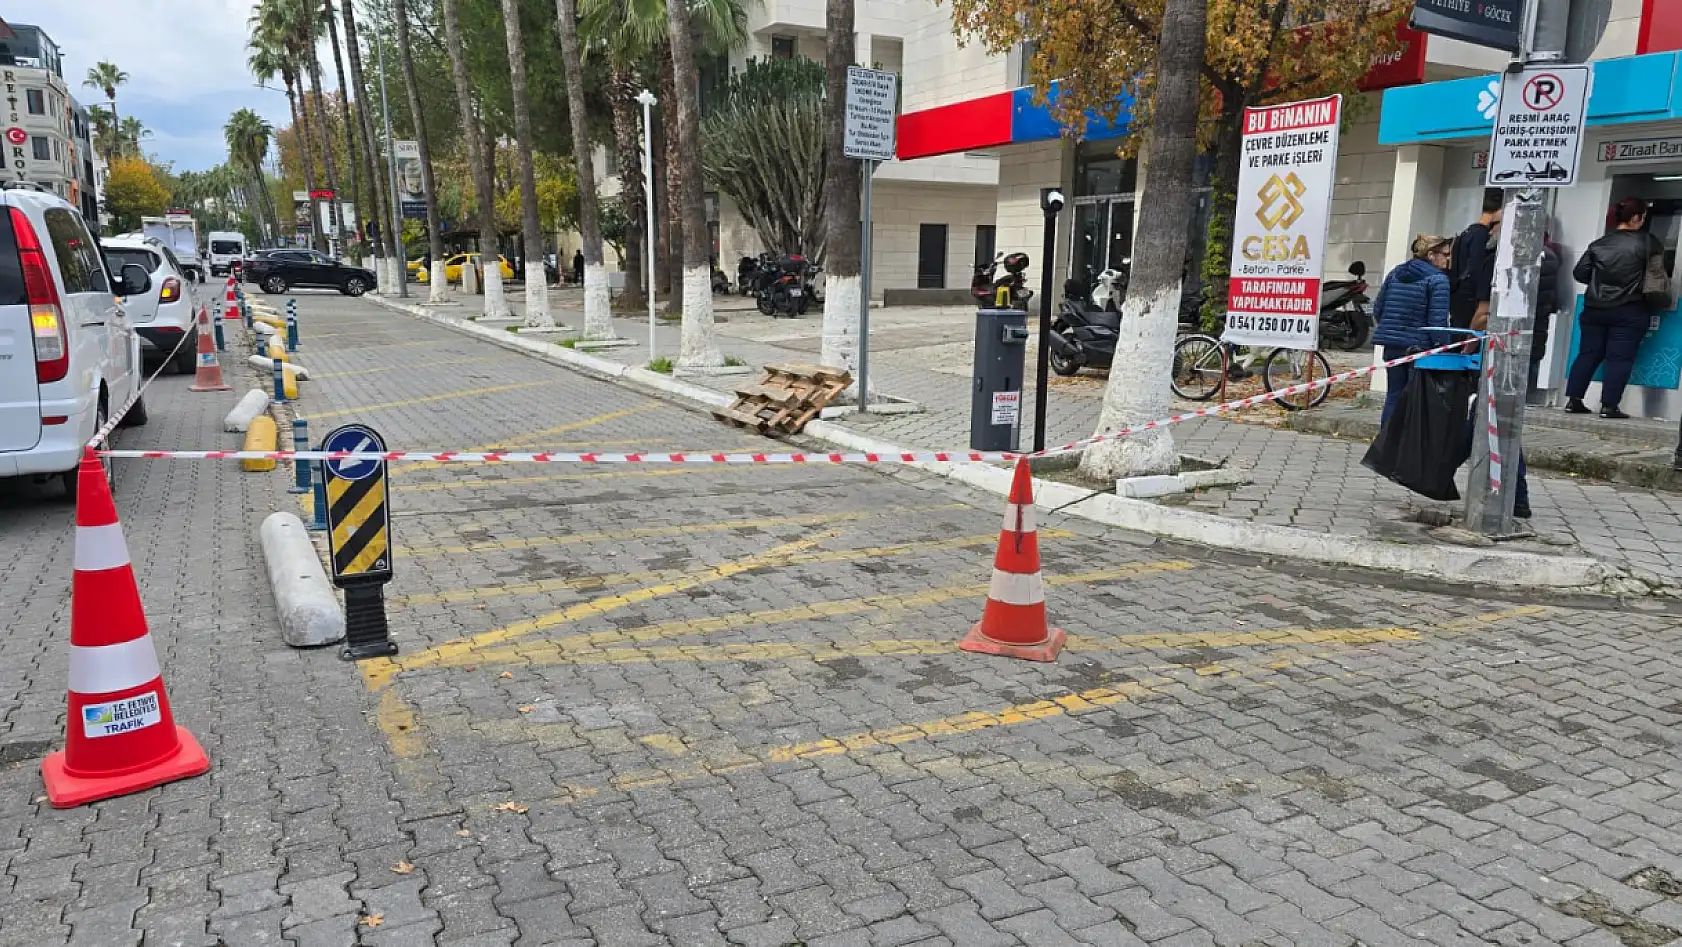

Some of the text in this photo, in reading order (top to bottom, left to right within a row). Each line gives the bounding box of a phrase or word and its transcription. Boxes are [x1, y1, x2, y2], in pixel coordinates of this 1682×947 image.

[1484, 4, 1512, 23] GÖCEK
[1248, 102, 1331, 132] BU BİNANIN
[1509, 112, 1570, 124] RESMİ ARAÇ
[1499, 124, 1576, 136] GİRİŞ-ÇIKIŞIDIR
[1245, 131, 1329, 154] ÇEVRE DÜZENLEME
[1504, 138, 1568, 147] PARK ETMEK
[1620, 142, 1658, 157] Ziraat
[1249, 149, 1323, 168] VE PARKE İŞLERİ
[1510, 150, 1559, 159] YASAKTIR
[1241, 234, 1311, 261] CESA
[1243, 264, 1304, 274] Beton Parke
[1241, 281, 1305, 295] TARAFINDAN
[1233, 295, 1313, 311] YAPILMAKTADIR
[1229, 315, 1310, 333] 0 541 250 07 04
[104, 718, 144, 733] TRAFİK
